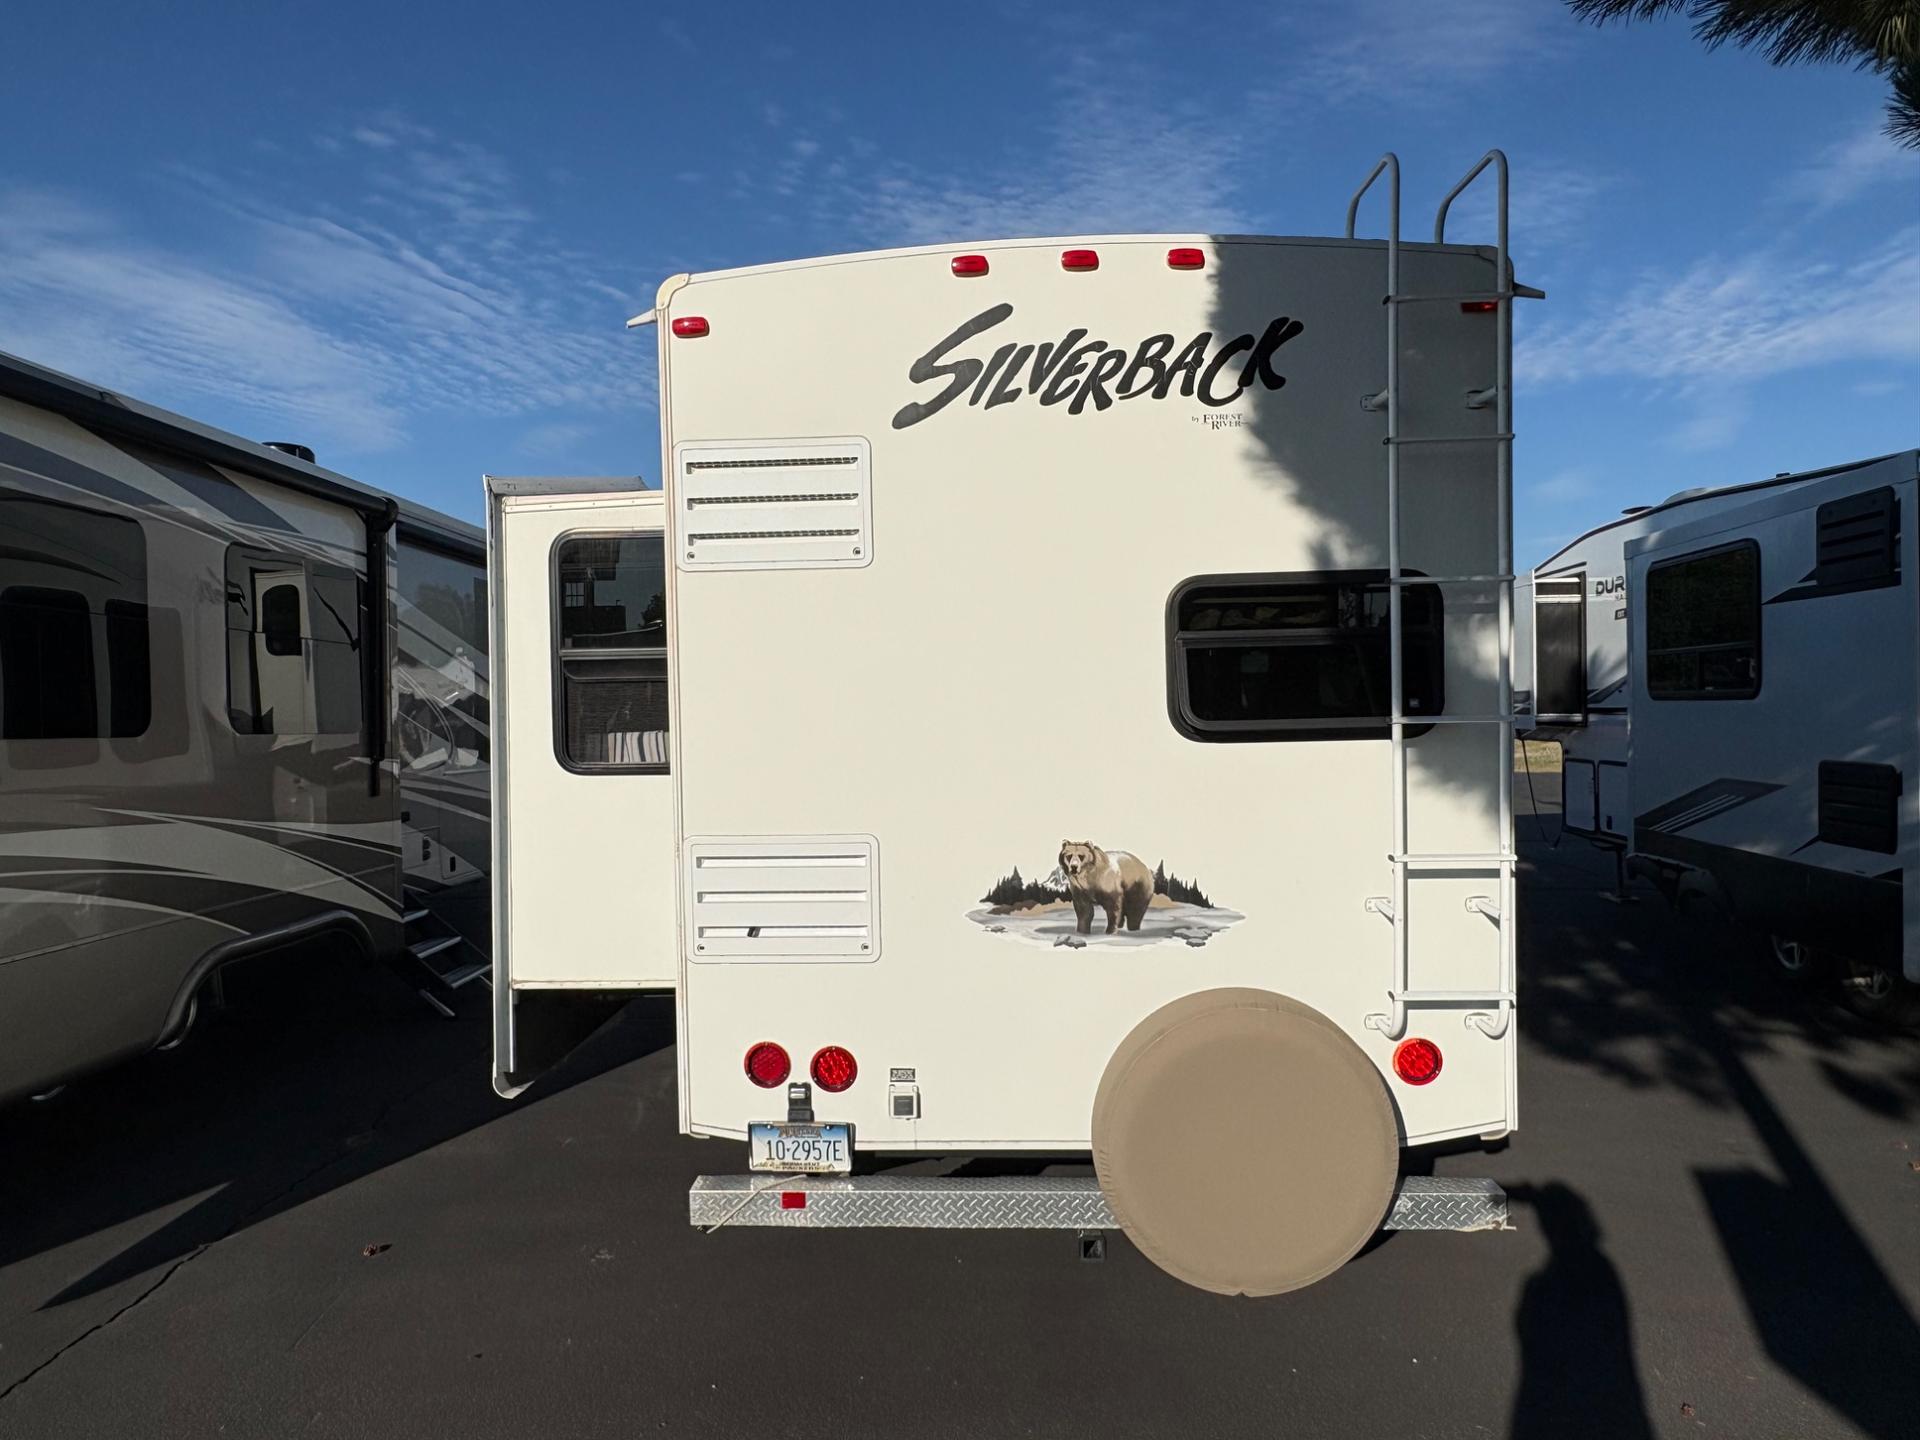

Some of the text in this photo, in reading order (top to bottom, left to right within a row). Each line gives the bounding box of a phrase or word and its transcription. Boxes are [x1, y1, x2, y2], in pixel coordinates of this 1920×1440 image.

[891, 302, 1305, 430] SILVERBACK
[1203, 413, 1243, 424] FOREST
[1211, 420, 1242, 430] RIVER
